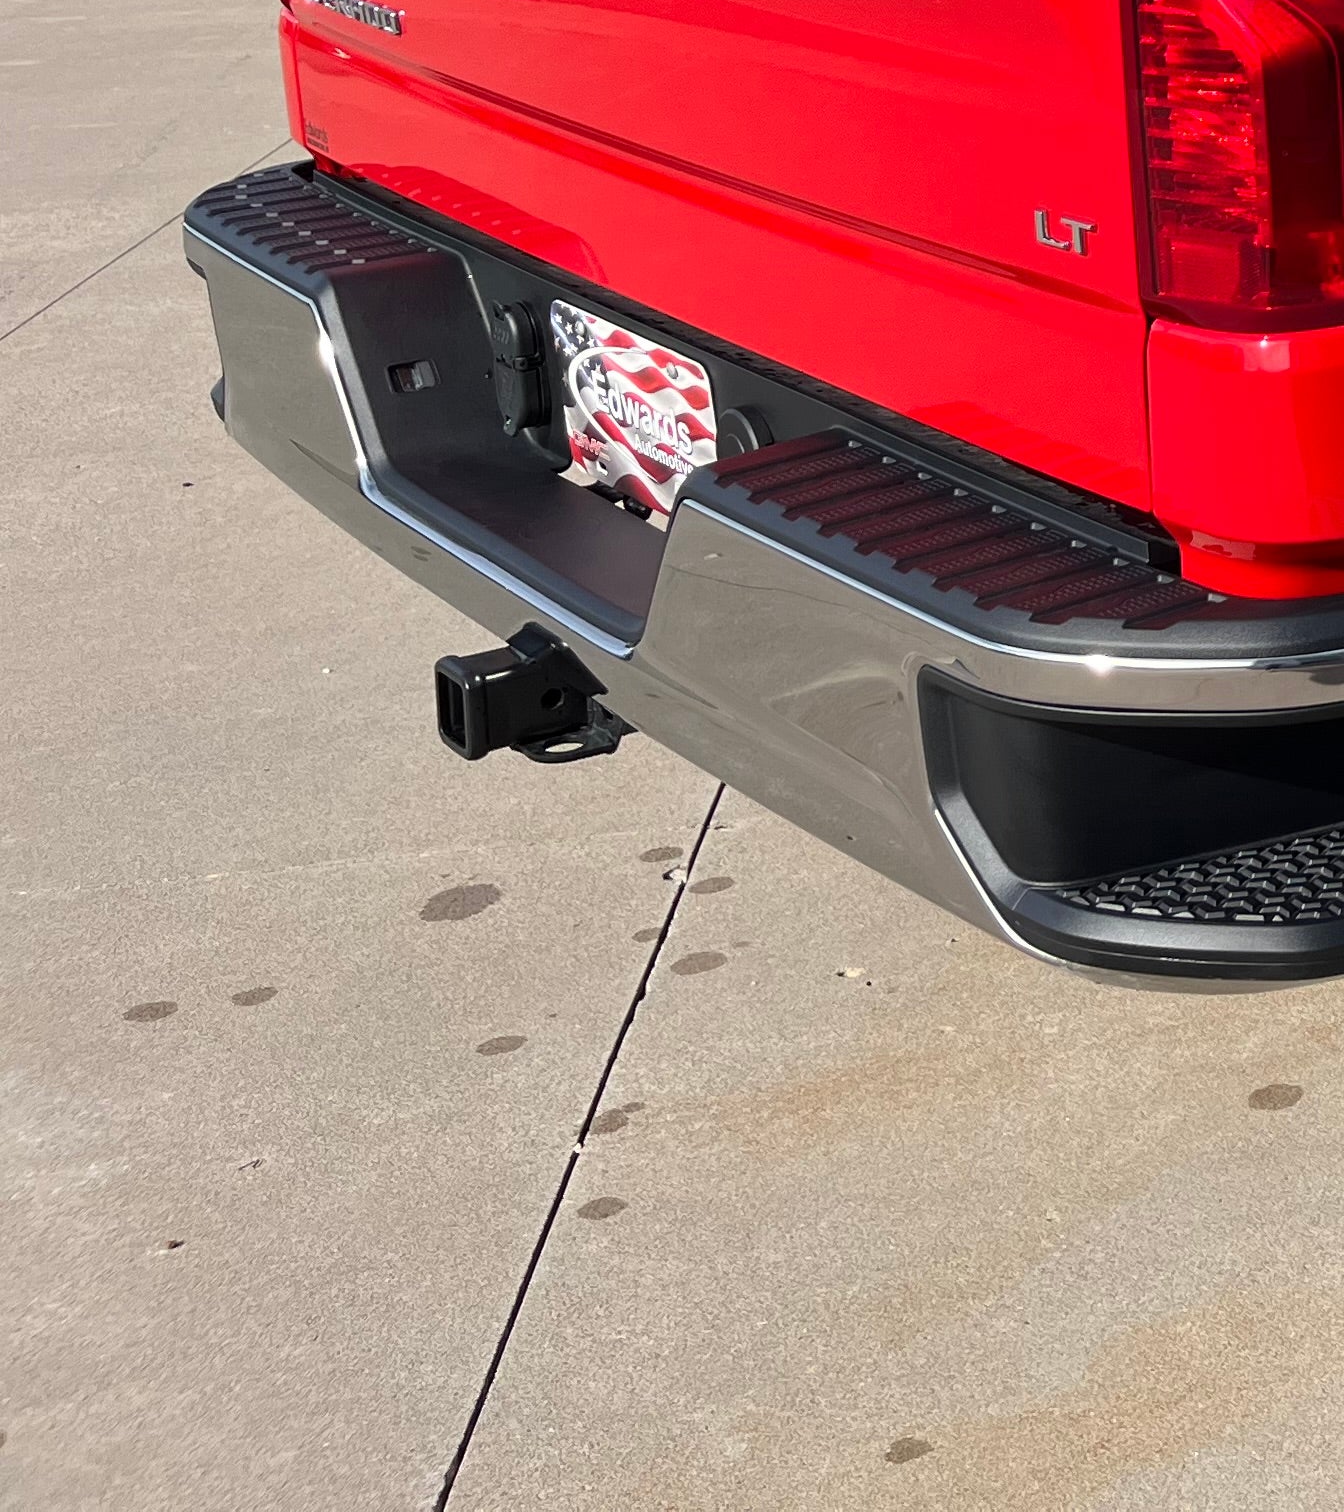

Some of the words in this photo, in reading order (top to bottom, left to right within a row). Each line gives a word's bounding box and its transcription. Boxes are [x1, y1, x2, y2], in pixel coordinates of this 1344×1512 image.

[1034, 208, 1097, 256] LT
[590, 368, 694, 456] Edwards
[633, 433, 694, 475] Automotive
